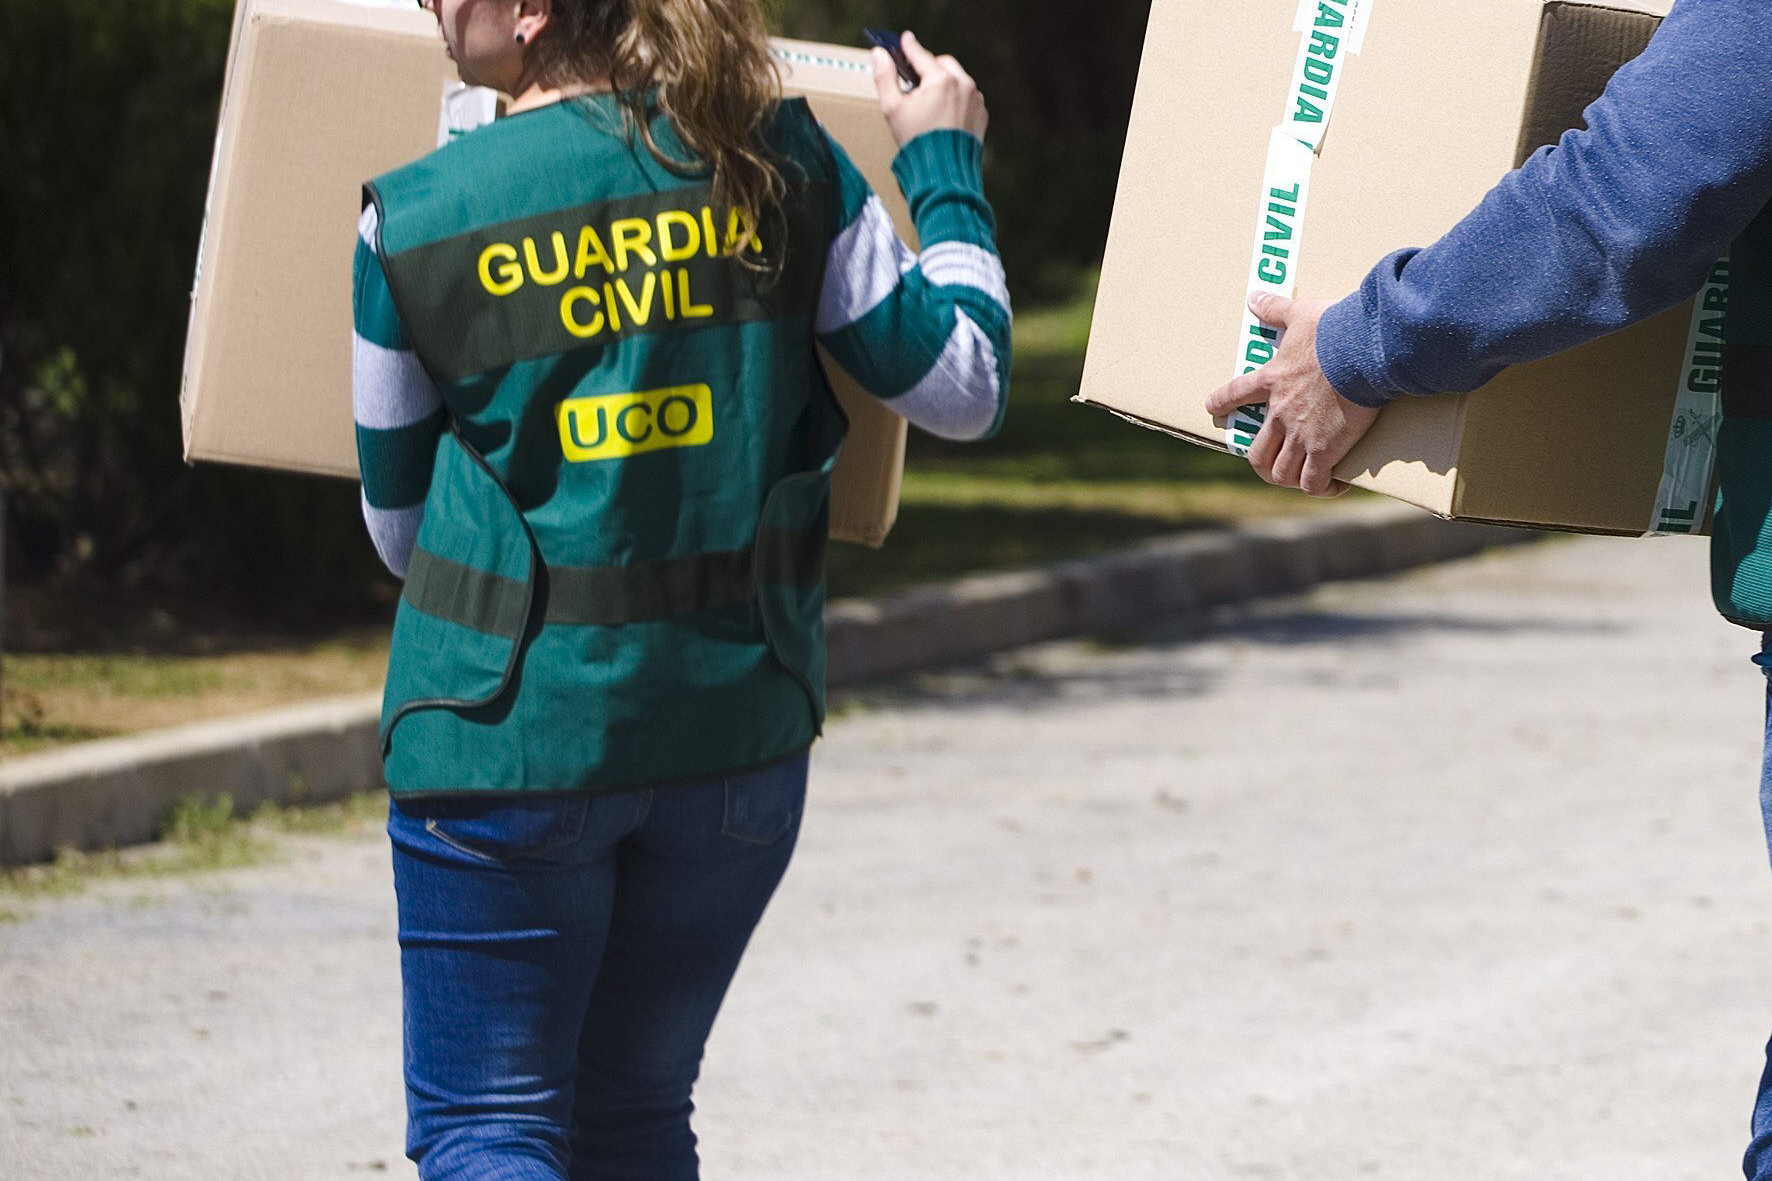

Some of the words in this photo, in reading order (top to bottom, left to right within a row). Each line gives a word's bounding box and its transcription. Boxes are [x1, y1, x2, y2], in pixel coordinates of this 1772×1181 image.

[477, 206, 763, 296] GUARDIA
[1258, 182, 1300, 285] CIVIL
[559, 268, 714, 338] CIVIL
[1686, 256, 1730, 394] GUARD
[568, 396, 698, 449] UCO
